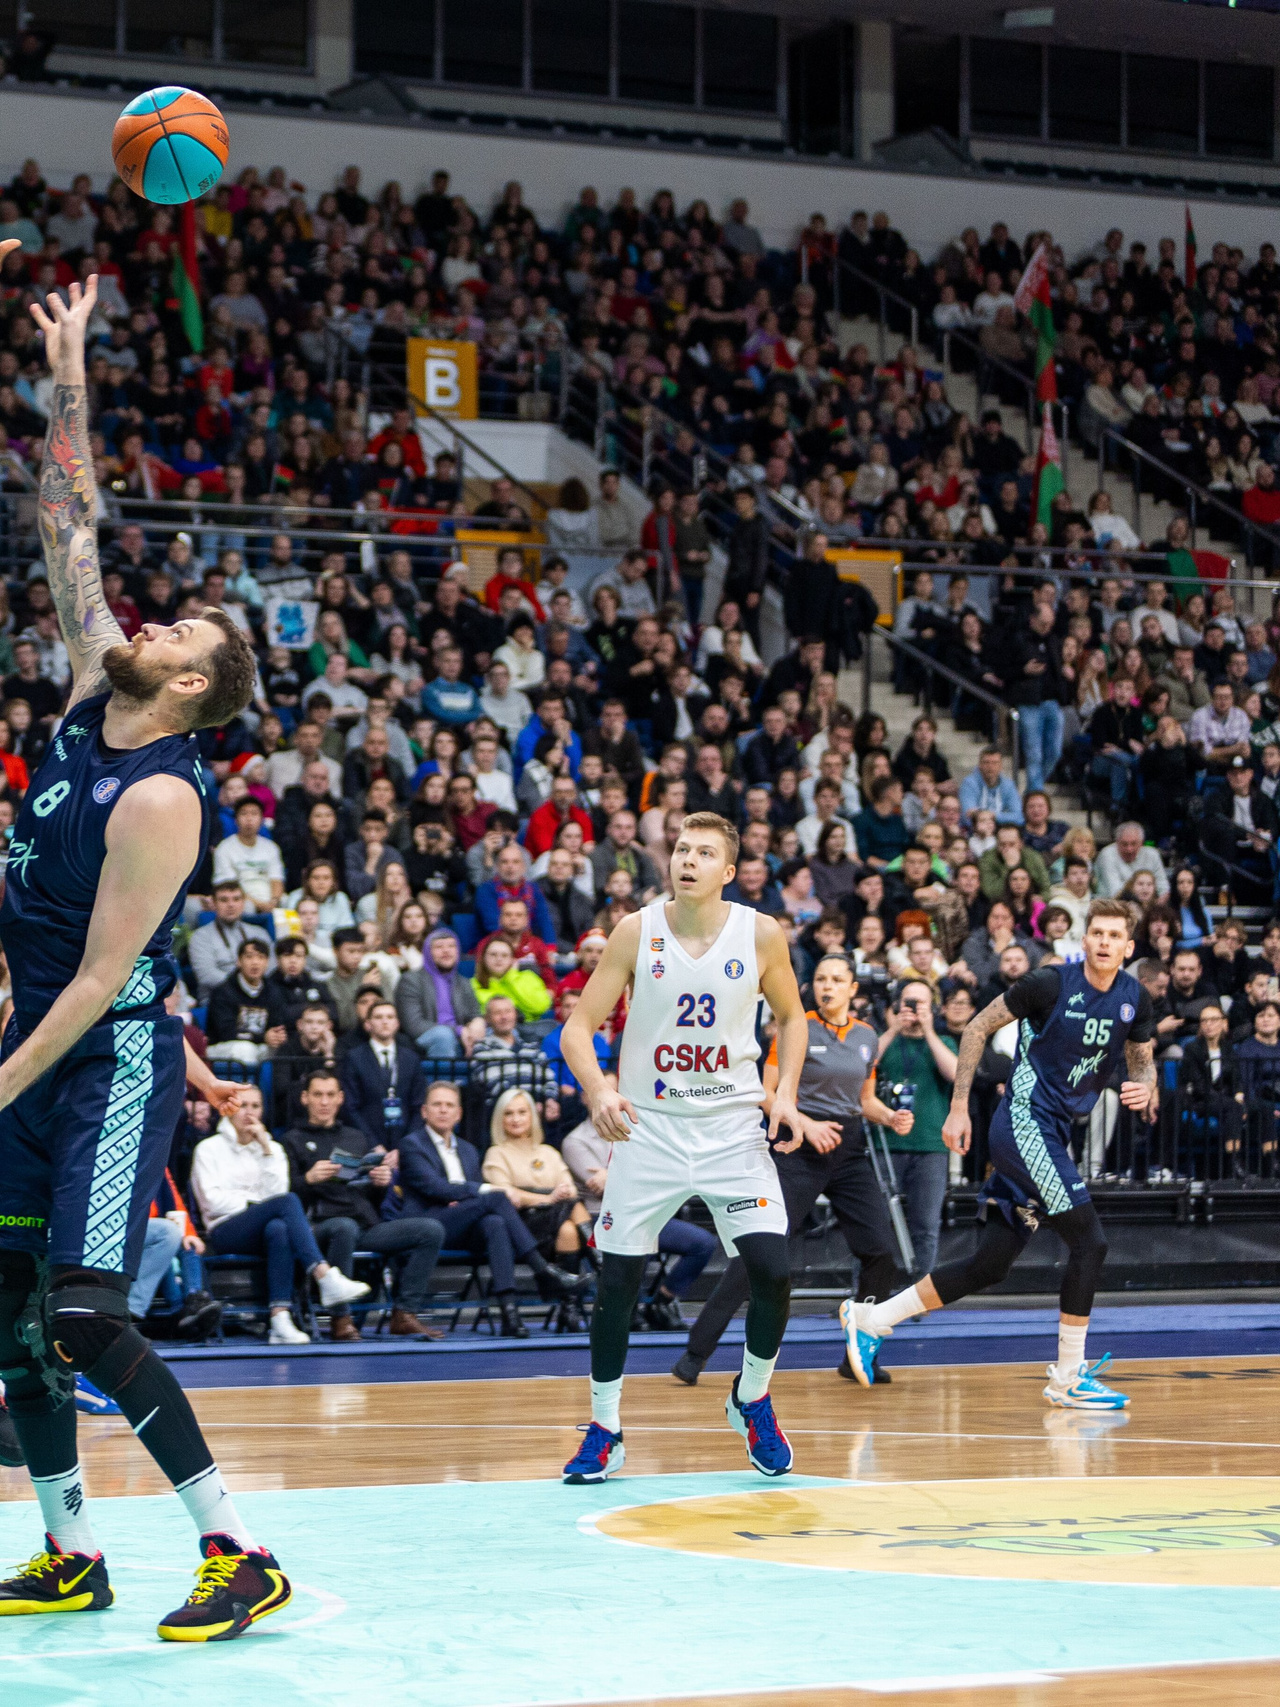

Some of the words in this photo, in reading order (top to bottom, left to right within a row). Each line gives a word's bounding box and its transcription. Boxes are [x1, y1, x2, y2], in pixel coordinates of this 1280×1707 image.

[32, 780, 71, 817] 8
[676, 992, 716, 1028] 23
[1082, 1018, 1114, 1046] 95
[654, 1043, 730, 1073] CSKA
[669, 1083, 736, 1098] Rostelecom
[728, 1200, 756, 1212] Winline
